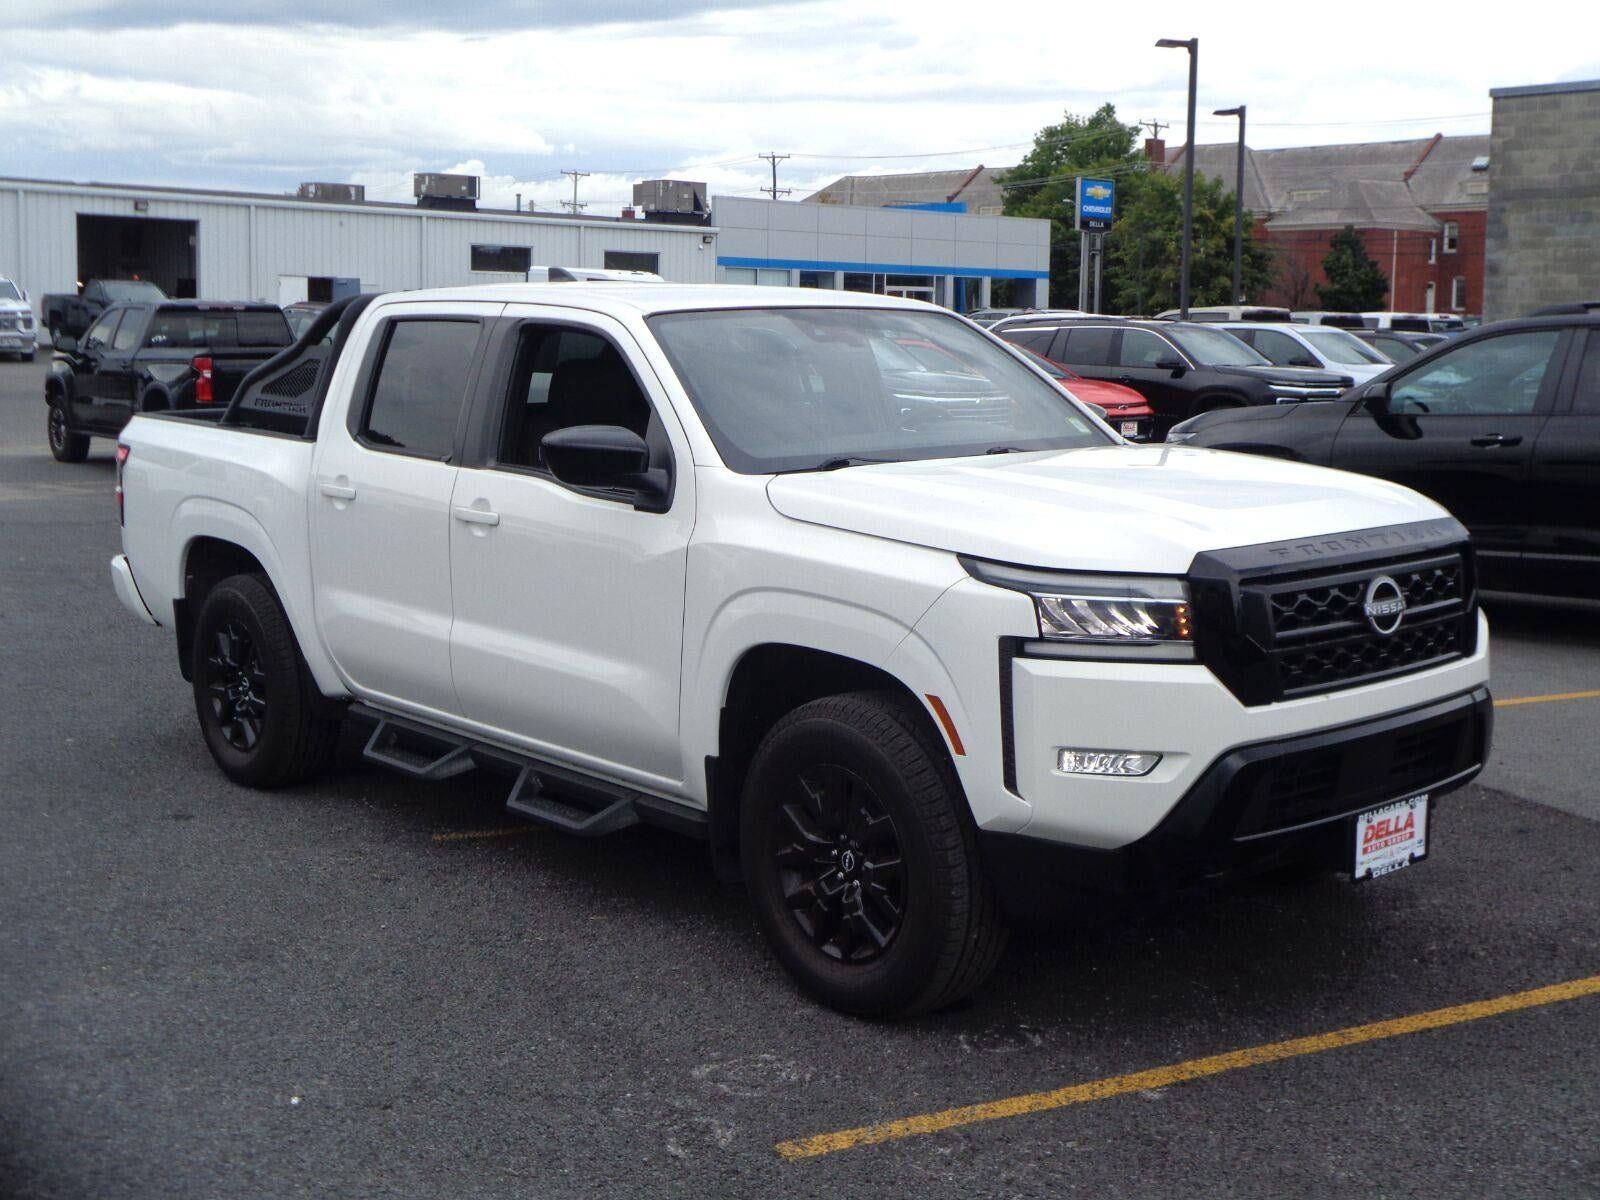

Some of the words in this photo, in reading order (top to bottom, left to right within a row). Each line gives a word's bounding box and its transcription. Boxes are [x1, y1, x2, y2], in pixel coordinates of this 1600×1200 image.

[1269, 524, 1442, 559] FRONTIER
[1362, 811, 1414, 845] DELLA
[1373, 861, 1409, 878] DELLA
